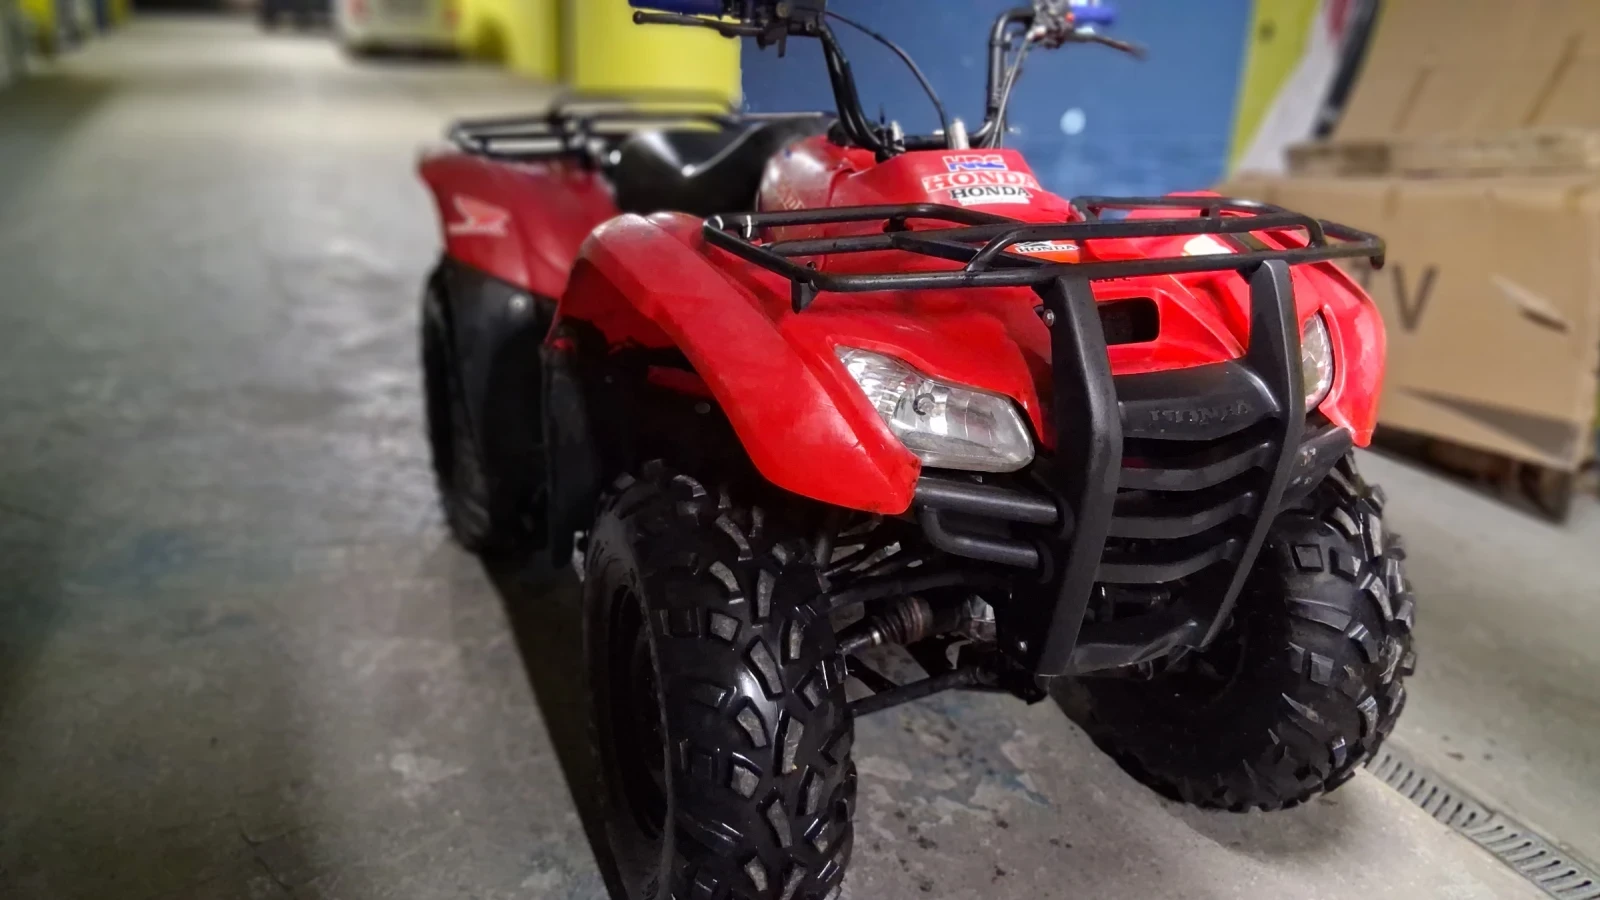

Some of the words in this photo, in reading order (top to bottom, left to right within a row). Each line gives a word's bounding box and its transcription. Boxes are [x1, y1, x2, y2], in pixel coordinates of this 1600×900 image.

[943, 155, 1007, 171] HRC
[922, 171, 1041, 192] HONDA
[950, 186, 1030, 199] HONDA
[1018, 244, 1077, 253] HONDA
